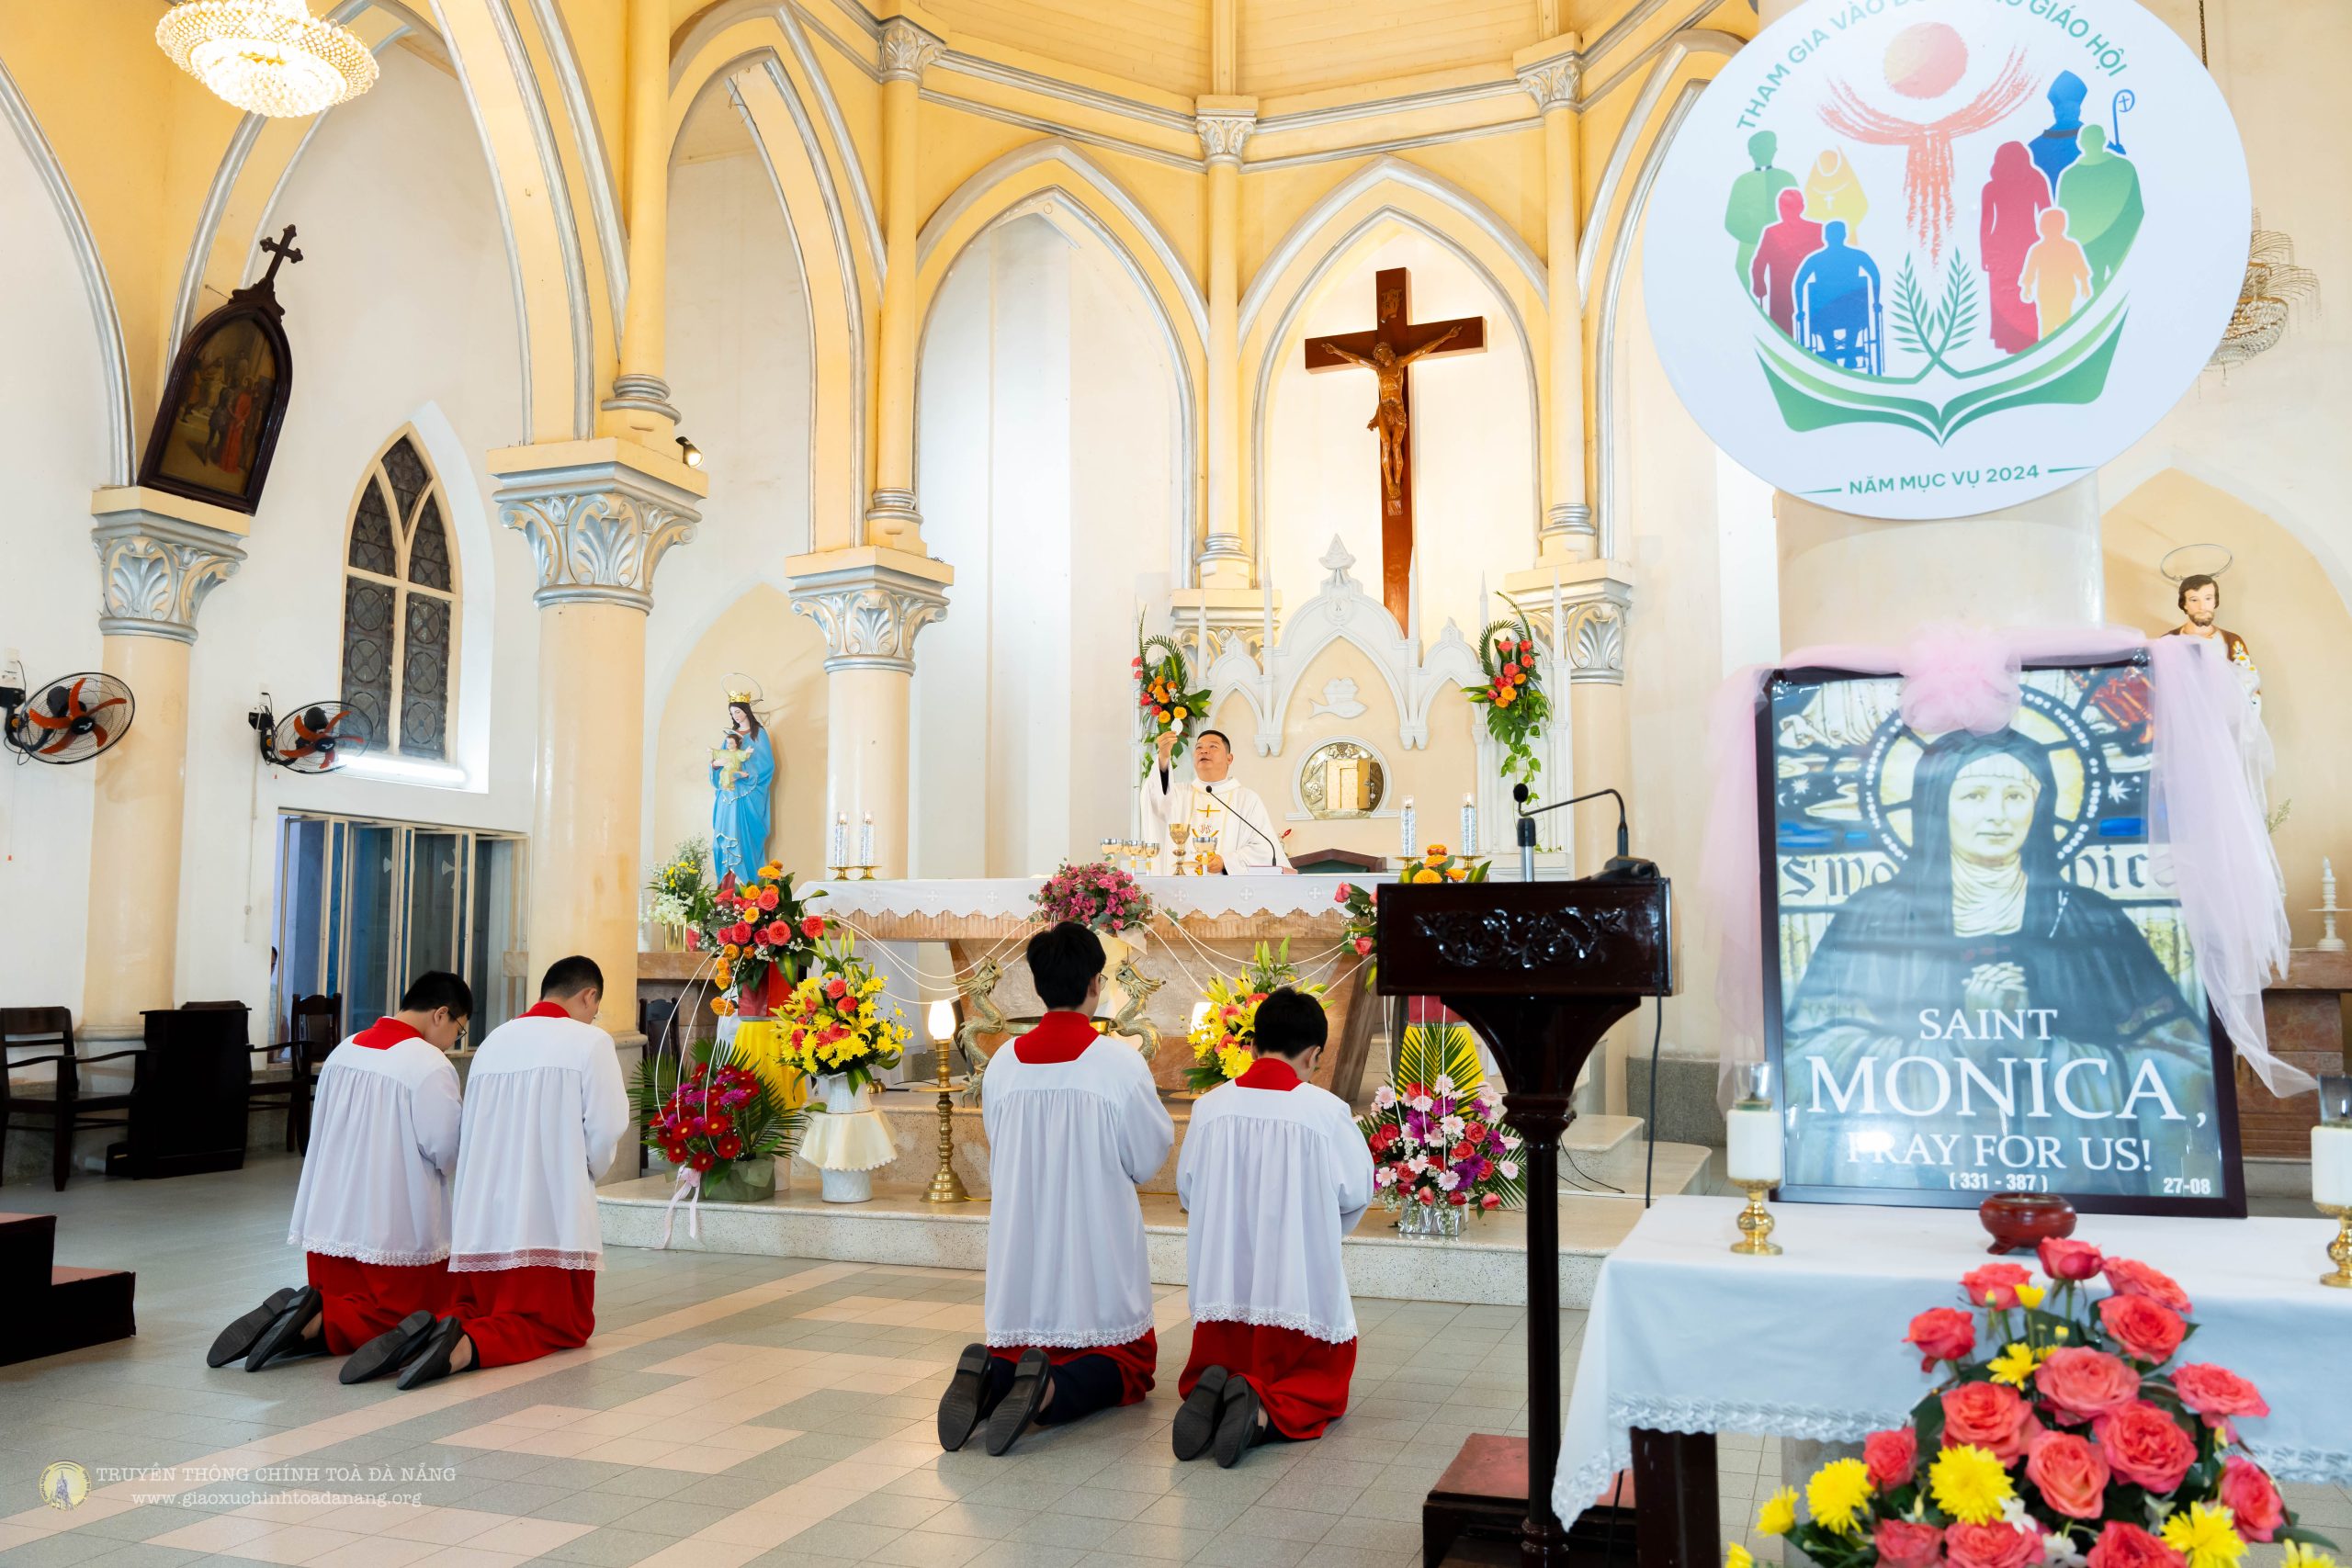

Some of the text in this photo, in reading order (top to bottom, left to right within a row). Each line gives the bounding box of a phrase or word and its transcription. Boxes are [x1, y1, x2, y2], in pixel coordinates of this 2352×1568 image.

[2030, 0, 2128, 77] GIÁO HỘI
[1736, 0, 1883, 129] THAM GIA VÀO
[1849, 465, 2039, 494] NĂM MỤC VỤ 2024
[1919, 1009, 2058, 1040] SAINT
[1805, 1056, 2207, 1128] MONICA,
[1973, 1134, 2066, 1169] FOR
[2080, 1138, 2153, 1171] US!
[2163, 1178, 2211, 1195] 27-08
